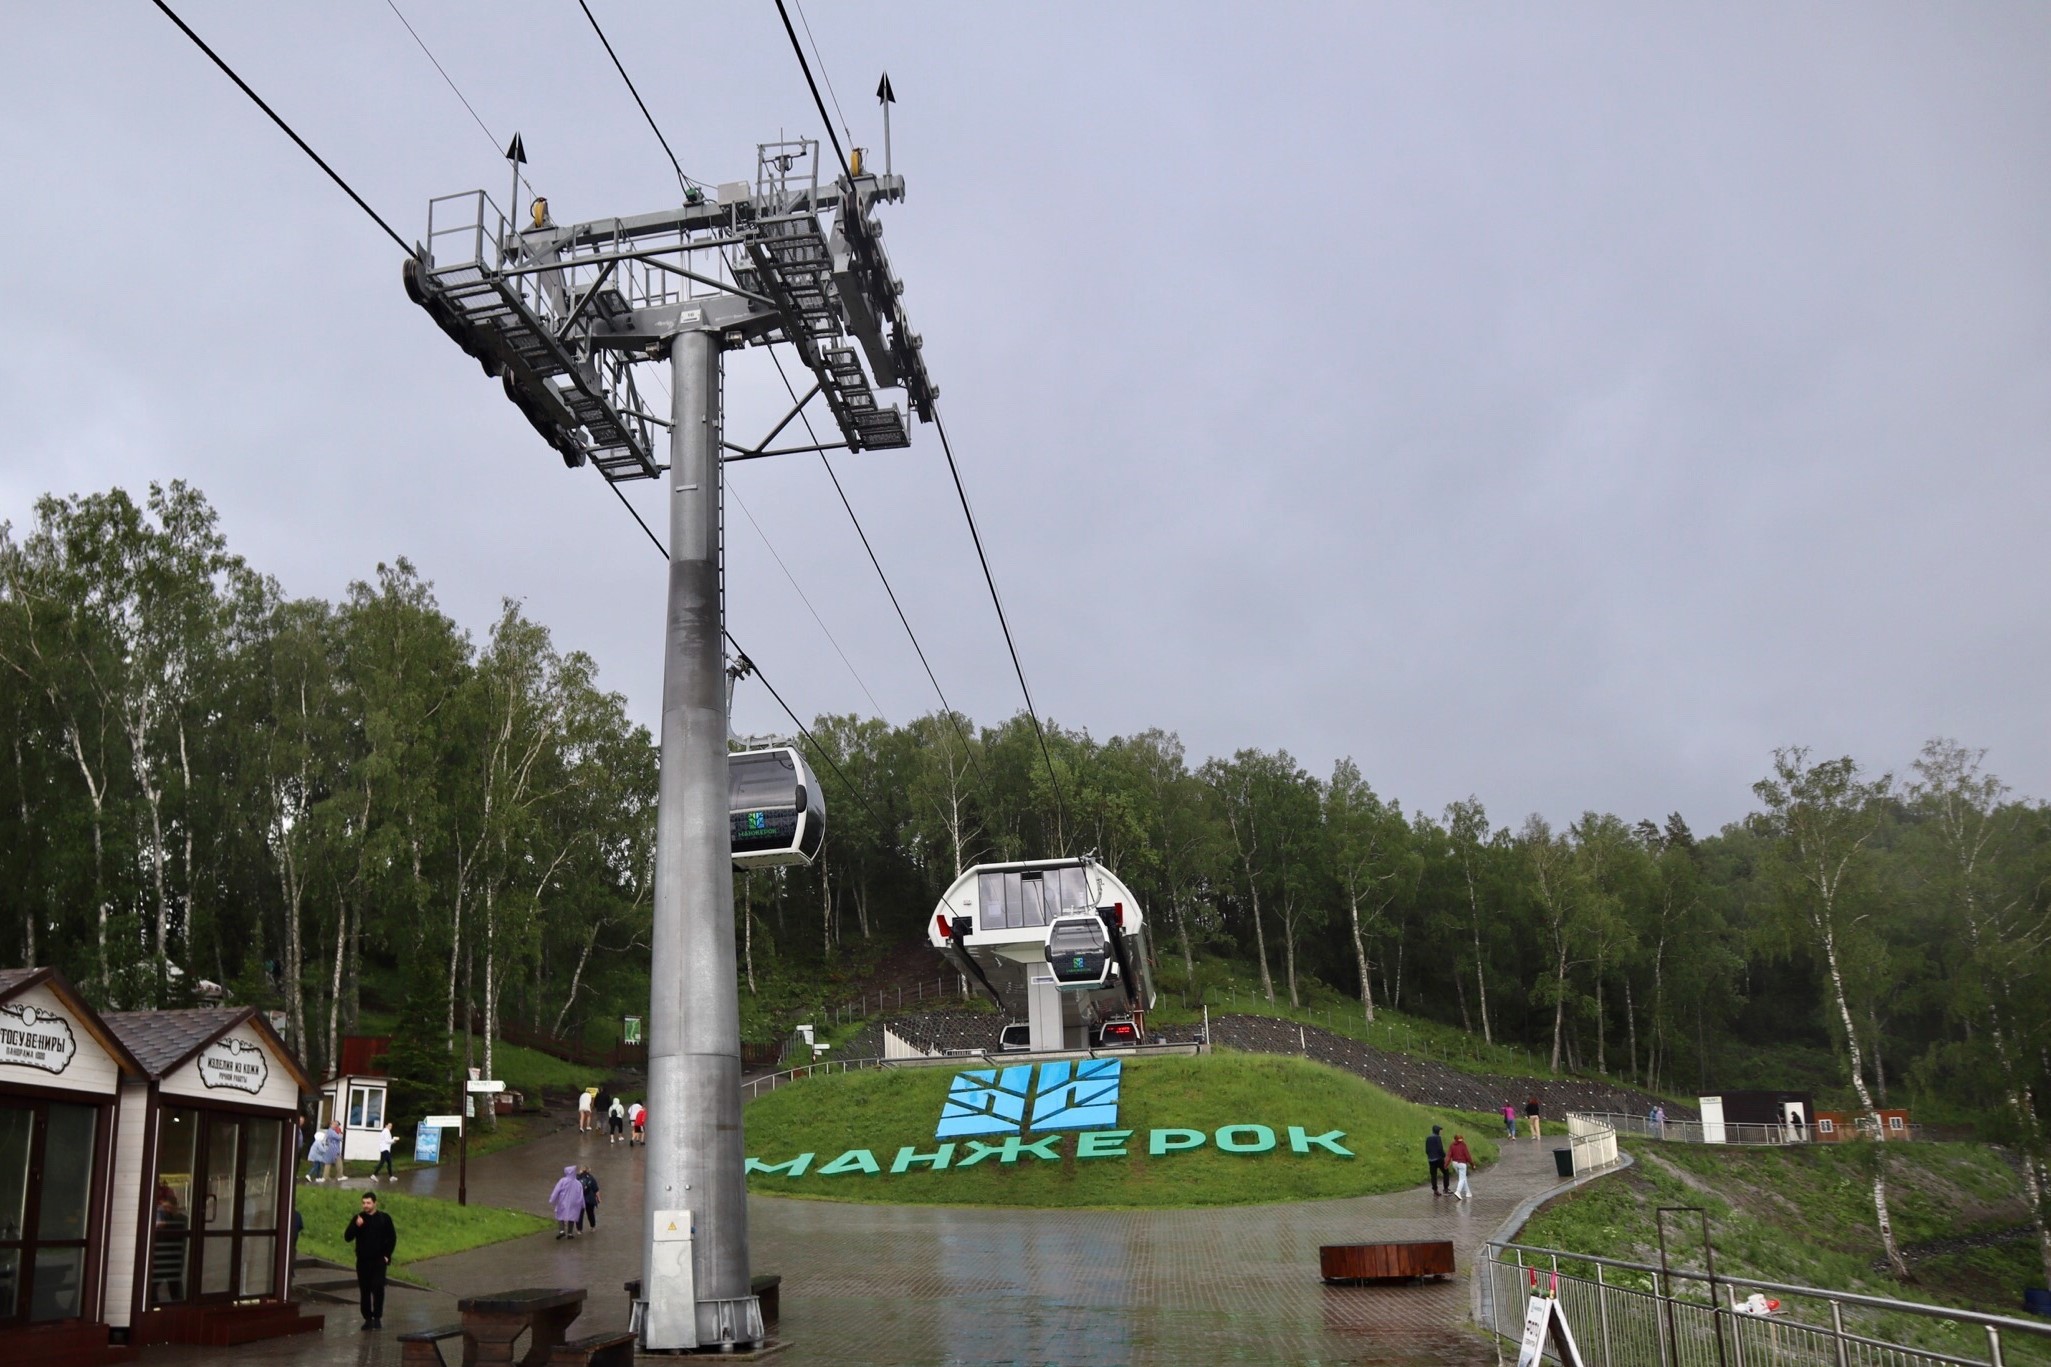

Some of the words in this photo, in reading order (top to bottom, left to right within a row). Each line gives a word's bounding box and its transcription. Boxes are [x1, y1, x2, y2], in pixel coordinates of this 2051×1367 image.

[6, 1047, 34, 1058] ПАНОРАМА
[208, 1057, 233, 1071] ИЗДЕЛИЯ
[235, 1062, 242, 1073] ИЗ
[243, 1063, 260, 1075] КОЖИ
[745, 1123, 1356, 1177] МАНЖЕРОК
